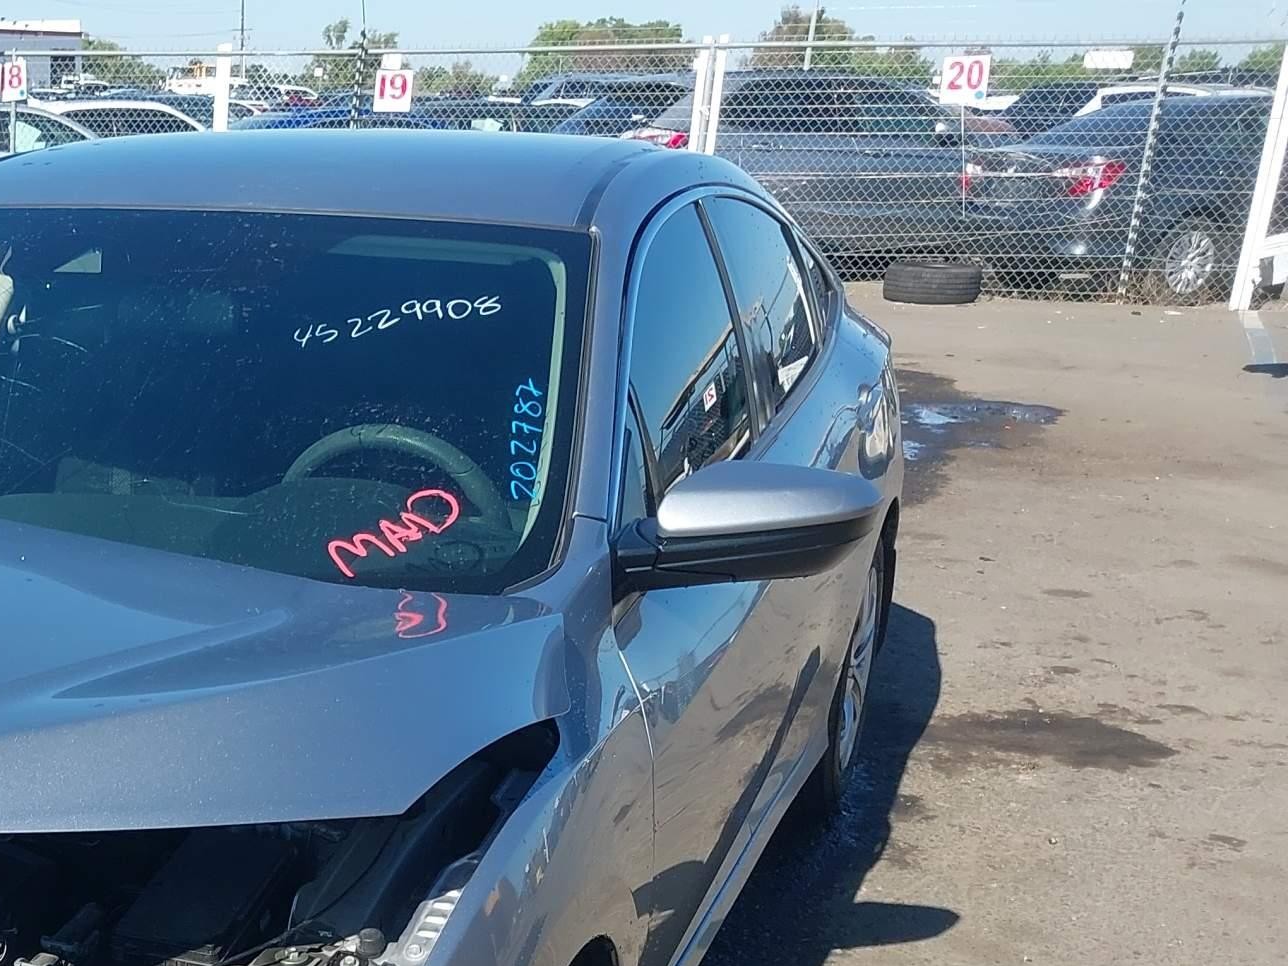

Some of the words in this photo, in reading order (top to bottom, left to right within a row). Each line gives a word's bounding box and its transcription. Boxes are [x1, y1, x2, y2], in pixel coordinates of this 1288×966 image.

[379, 74, 407, 100] 19
[946, 60, 984, 90] 20
[328, 488, 460, 578] MAD
